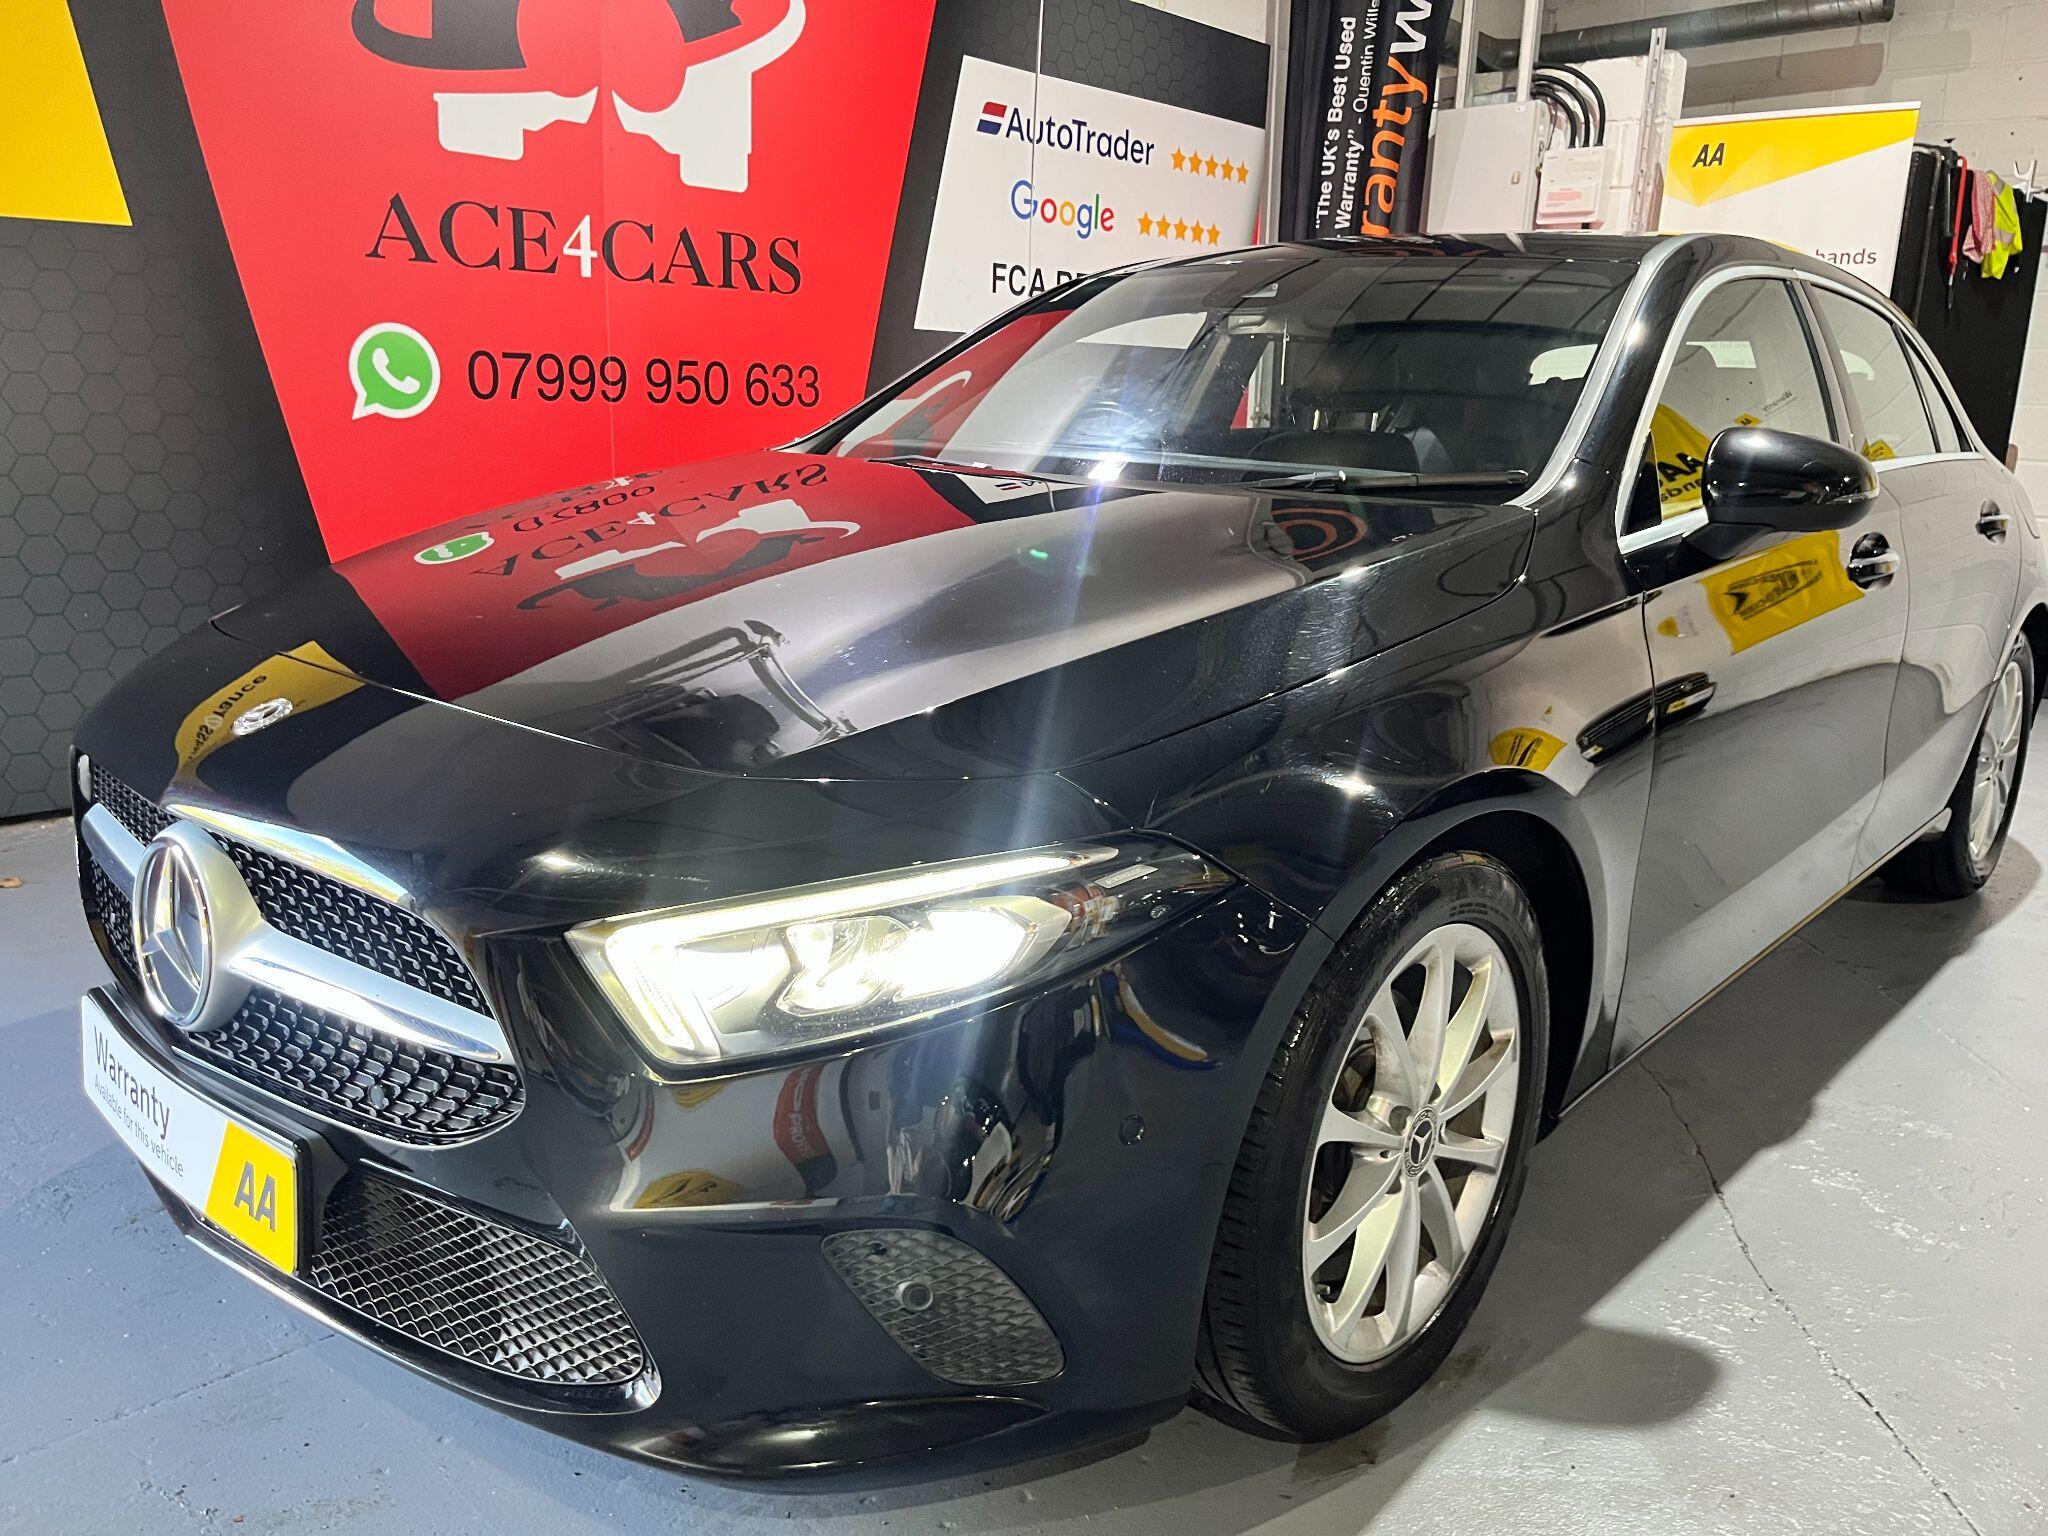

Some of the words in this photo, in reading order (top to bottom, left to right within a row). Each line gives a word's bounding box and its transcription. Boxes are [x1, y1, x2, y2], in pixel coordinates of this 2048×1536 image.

[1333, 16, 1357, 70] Used
[1327, 75, 1349, 123] Best
[1352, 44, 1375, 113] Quentin
[1005, 107, 1155, 165] AutoTrader
[1692, 142, 1725, 167] AA
[1011, 179, 1115, 240] Google
[365, 192, 802, 295] ACE4CARS
[992, 262, 1046, 297] FCA
[467, 350, 628, 402] 07999
[646, 360, 729, 406] 950
[745, 363, 820, 408] 633
[94, 1024, 170, 1140] Warranty
[94, 1073, 122, 1119] Available
[123, 1107, 134, 1132] for
[135, 1121, 150, 1148] this
[150, 1138, 184, 1178] vehicle
[233, 1161, 276, 1234] AA
